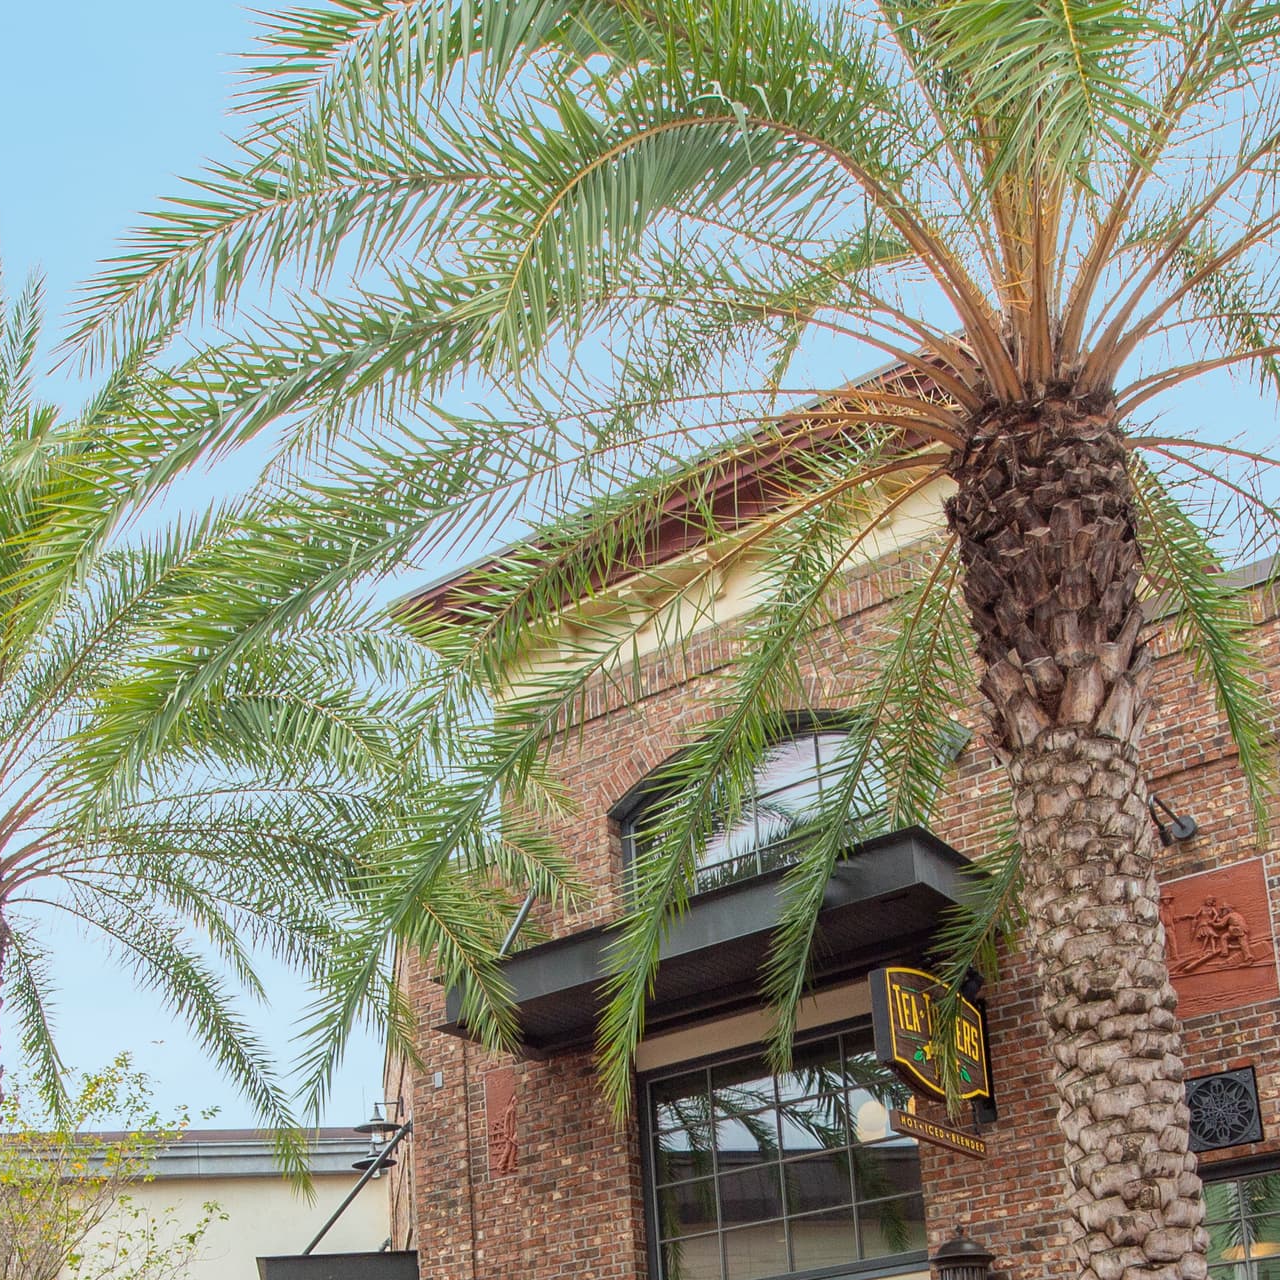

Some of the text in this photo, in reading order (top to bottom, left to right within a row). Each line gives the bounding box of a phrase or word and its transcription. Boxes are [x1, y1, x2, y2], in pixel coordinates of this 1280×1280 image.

[901, 1114, 986, 1153] HOT ICED BLENDED
